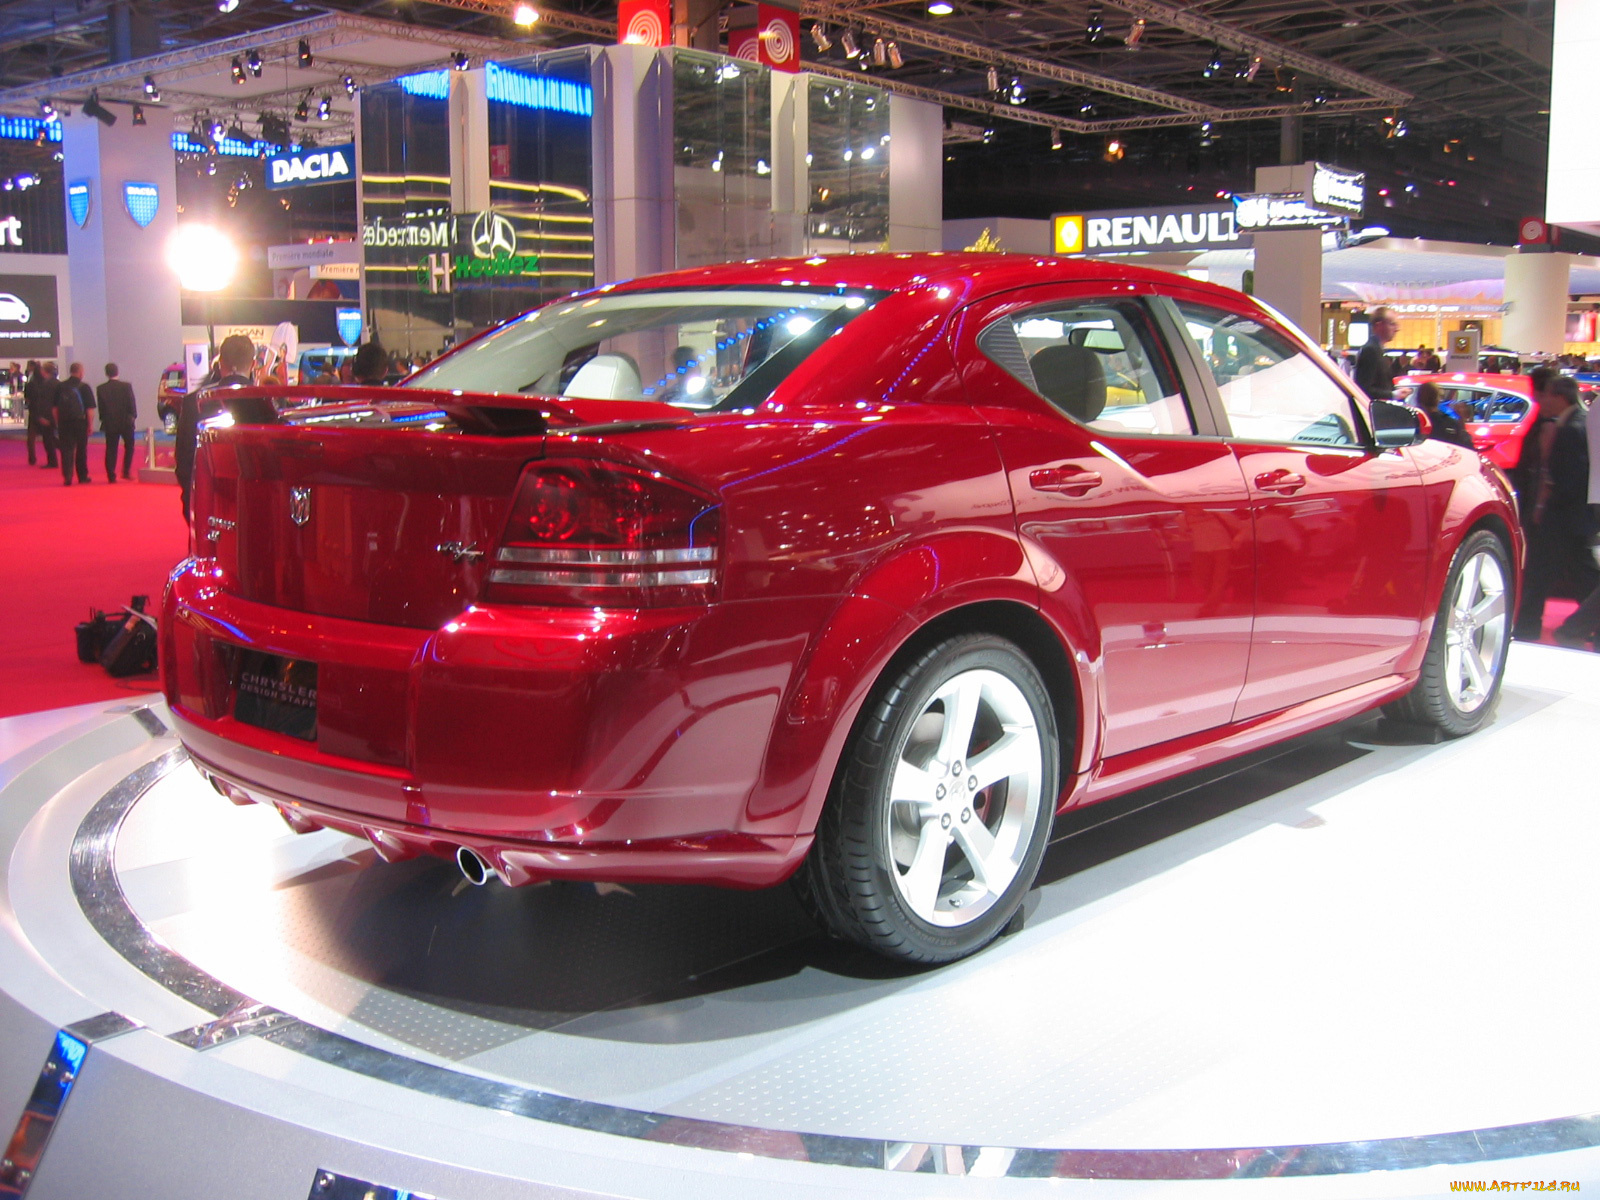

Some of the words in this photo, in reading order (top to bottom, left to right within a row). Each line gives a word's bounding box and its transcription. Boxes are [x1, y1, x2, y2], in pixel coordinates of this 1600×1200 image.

[272, 151, 349, 183] DACIA
[1087, 211, 1239, 248] RENAULT
[455, 253, 540, 279] Heuliez
[240, 683, 278, 698] DESIGN
[280, 693, 316, 708] STAFF
[241, 671, 317, 699] CHRYSLER
